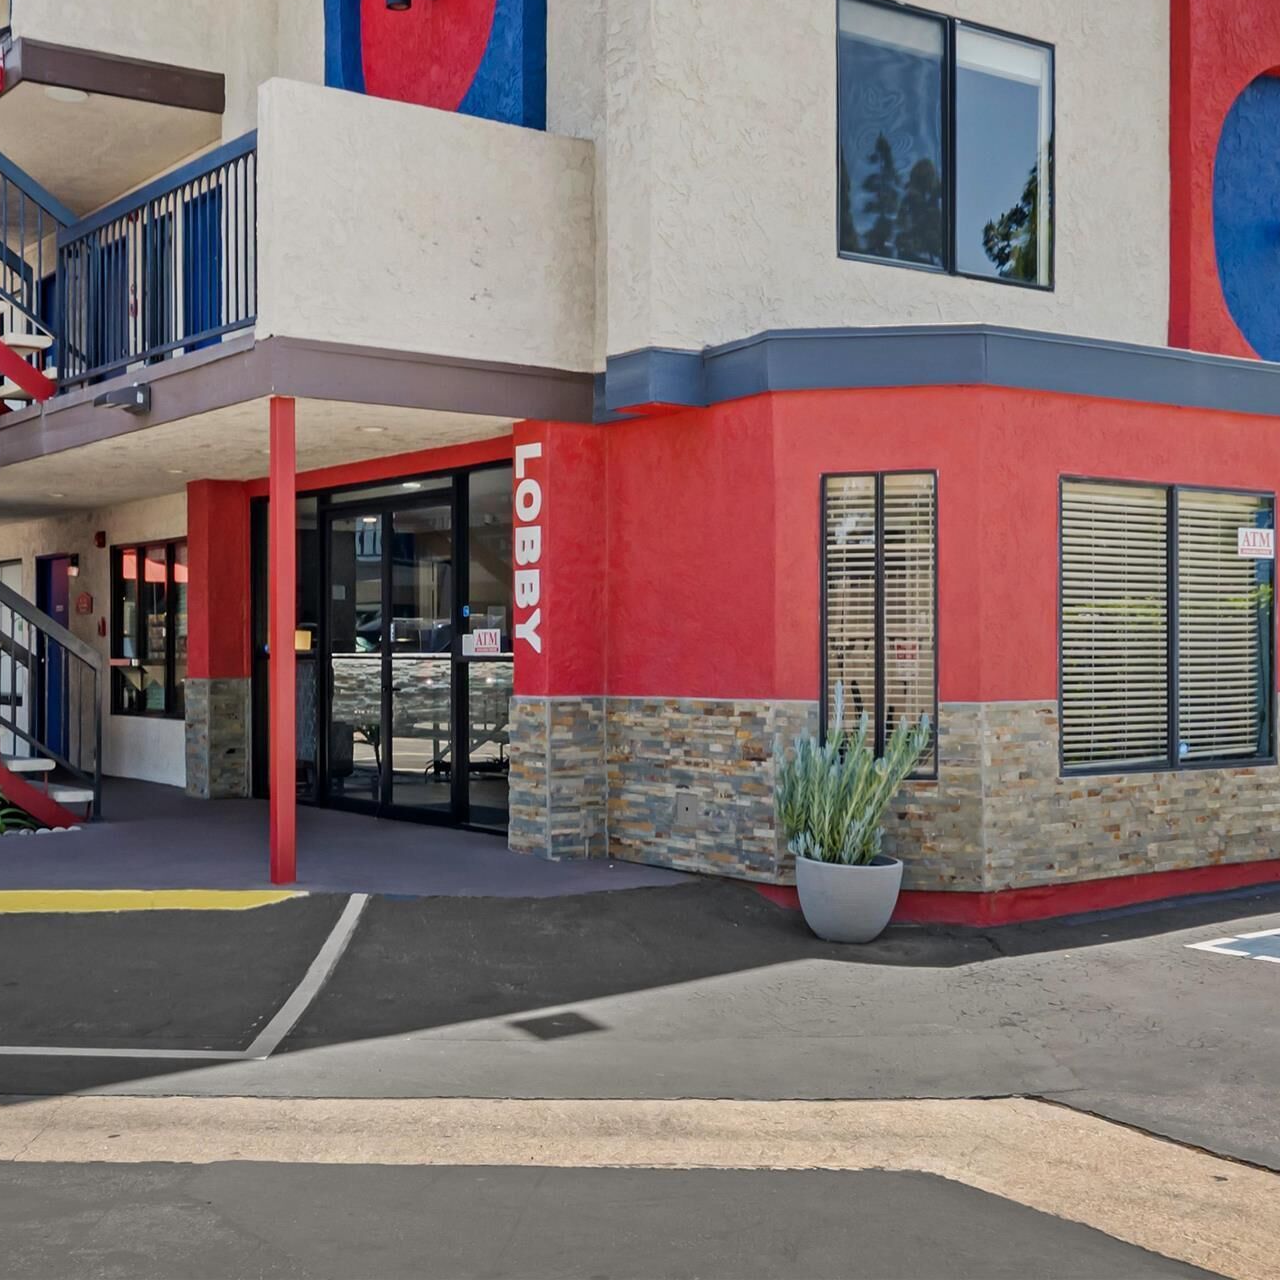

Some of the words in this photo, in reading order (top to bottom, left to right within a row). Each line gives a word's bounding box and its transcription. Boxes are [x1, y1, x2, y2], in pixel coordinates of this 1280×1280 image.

[1242, 531, 1271, 547] ATM
[515, 442, 542, 654] LOBBY
[476, 632, 497, 646] ATM
